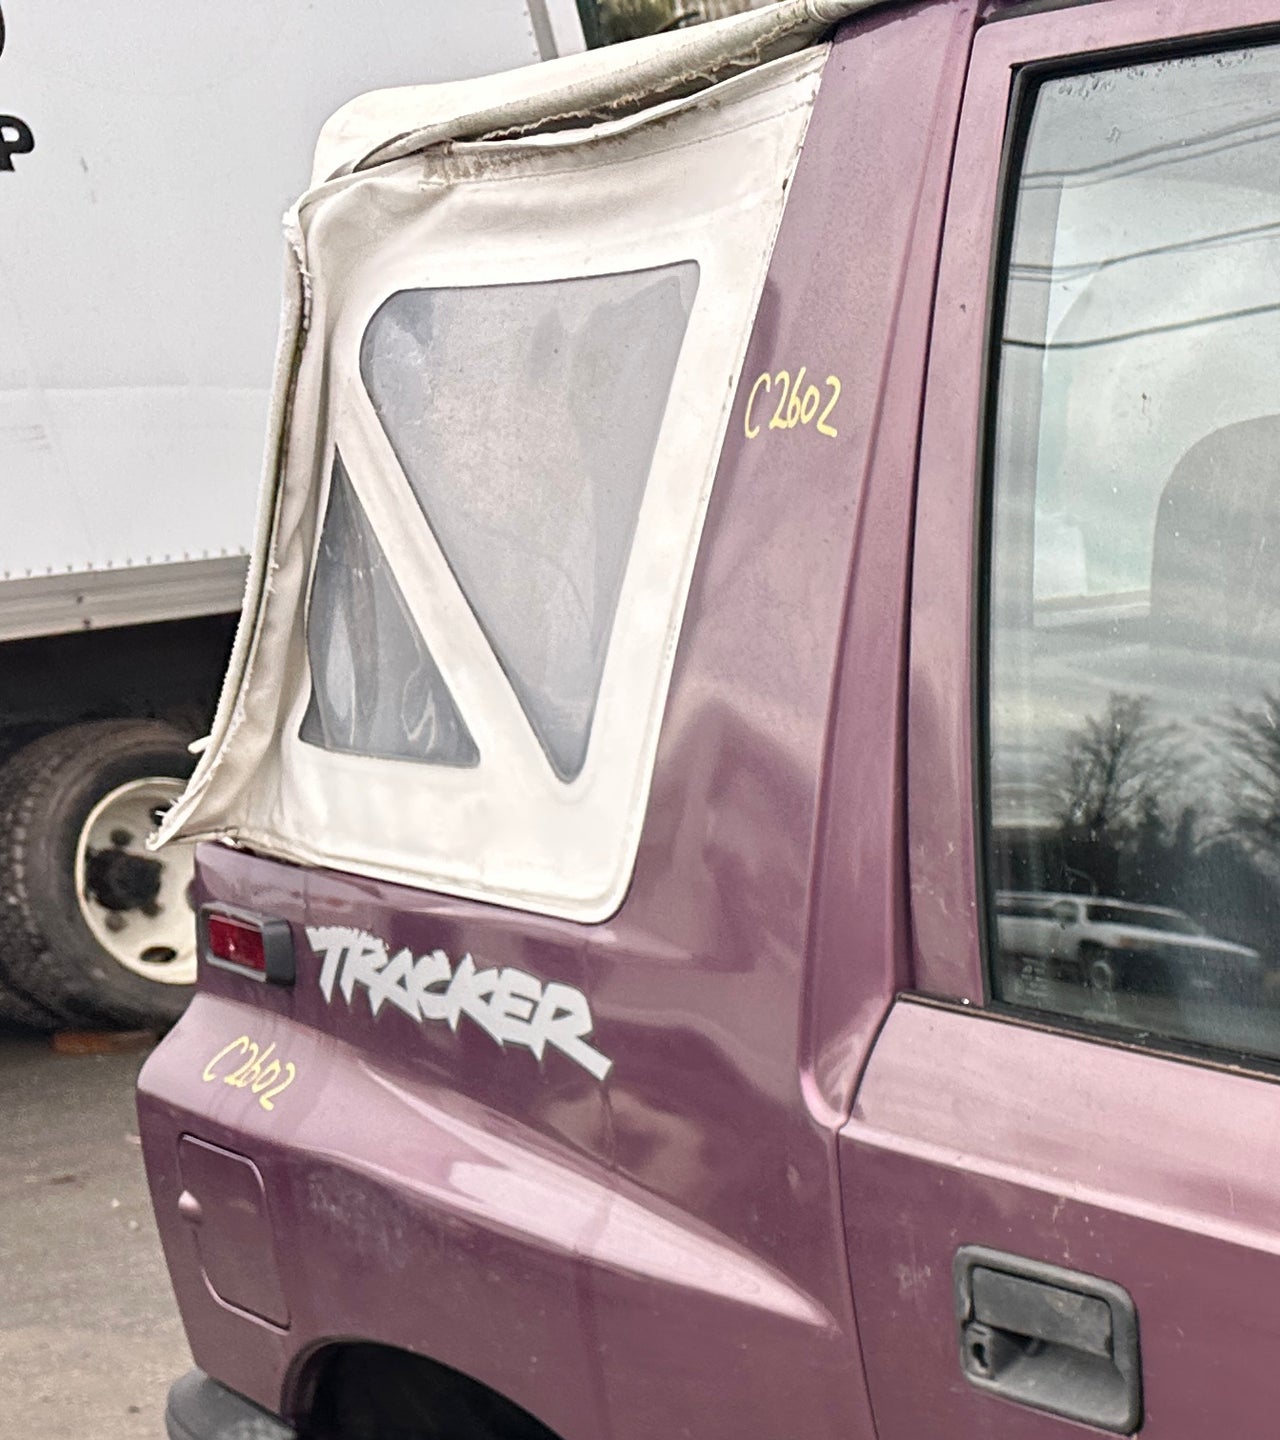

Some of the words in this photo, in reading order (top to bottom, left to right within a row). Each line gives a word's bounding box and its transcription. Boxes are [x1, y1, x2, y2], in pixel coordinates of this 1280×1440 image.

[744, 366, 841, 439] C2602
[305, 924, 614, 1081] TRACKER
[201, 1034, 296, 1111] C2602
